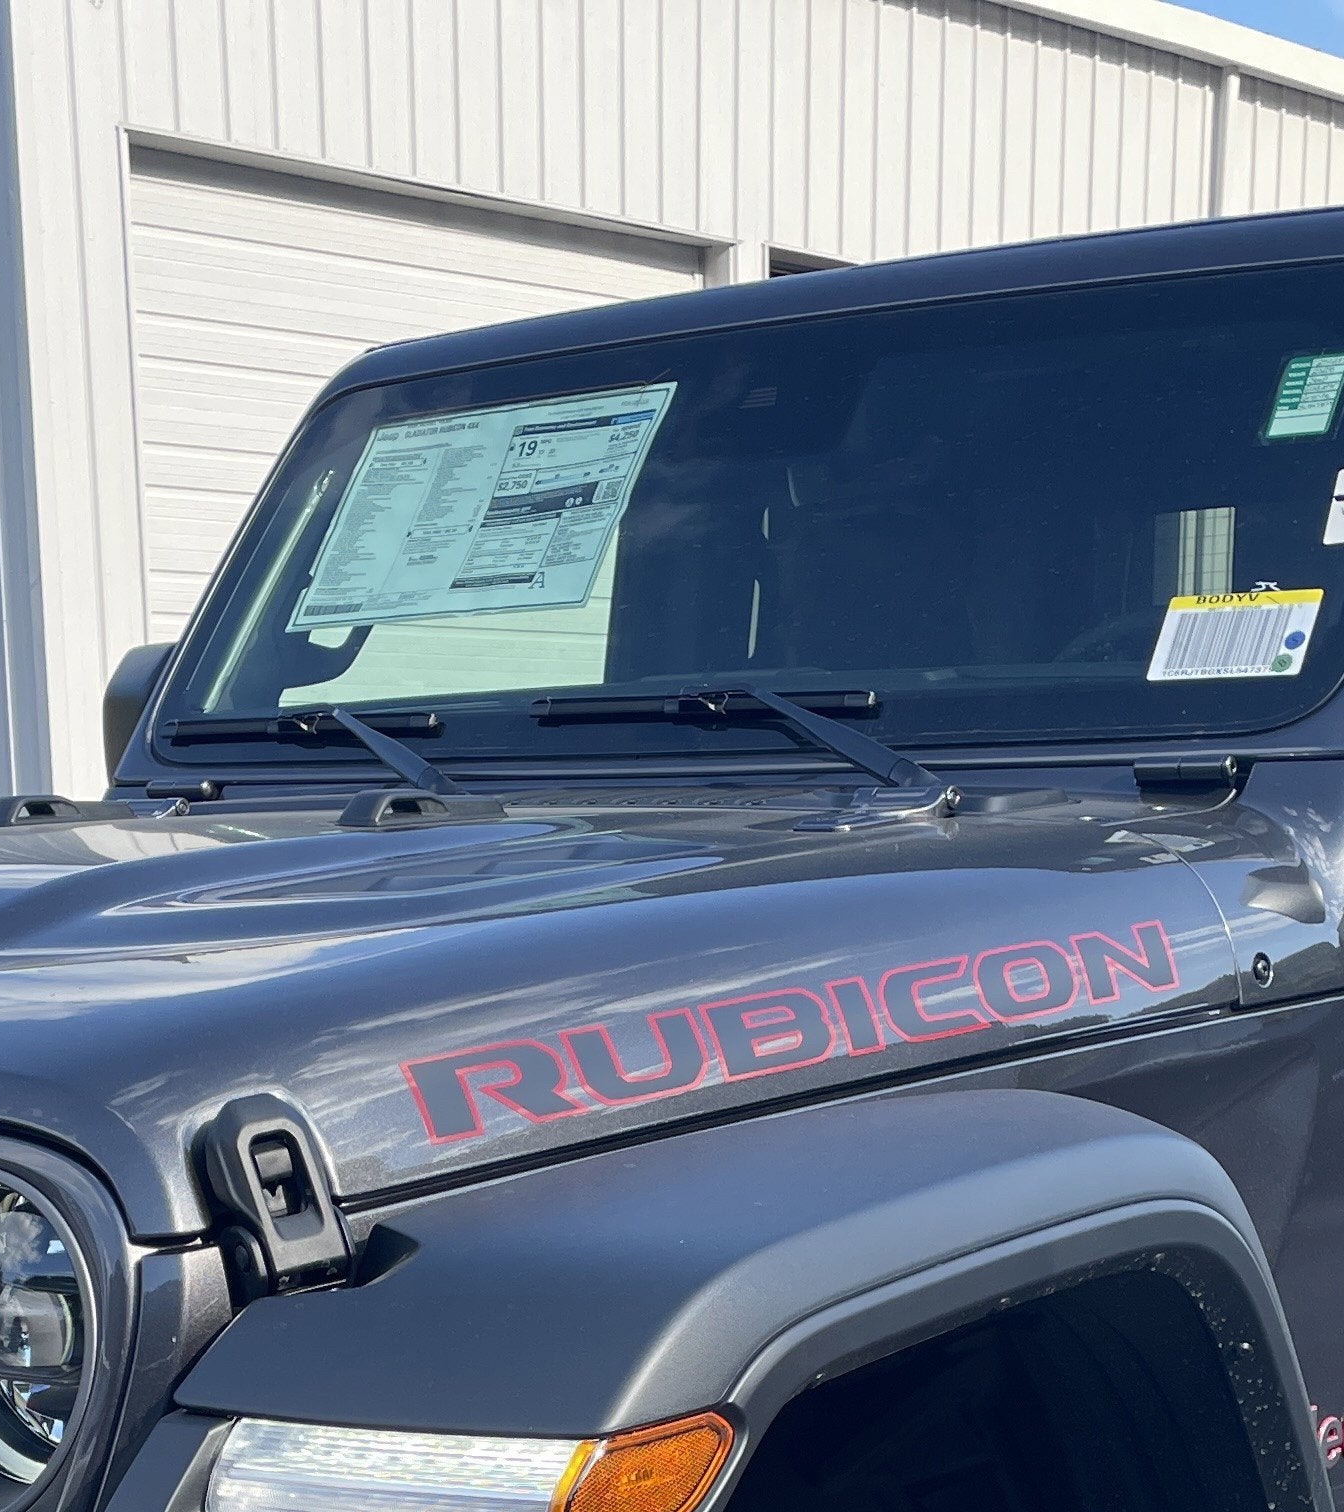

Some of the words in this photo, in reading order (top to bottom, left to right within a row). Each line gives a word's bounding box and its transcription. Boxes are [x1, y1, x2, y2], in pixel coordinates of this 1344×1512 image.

[518, 440, 538, 457] 19
[497, 480, 528, 492] $2,750
[1196, 593, 1261, 605] BODYV
[400, 919, 1180, 1145] RUBICON
